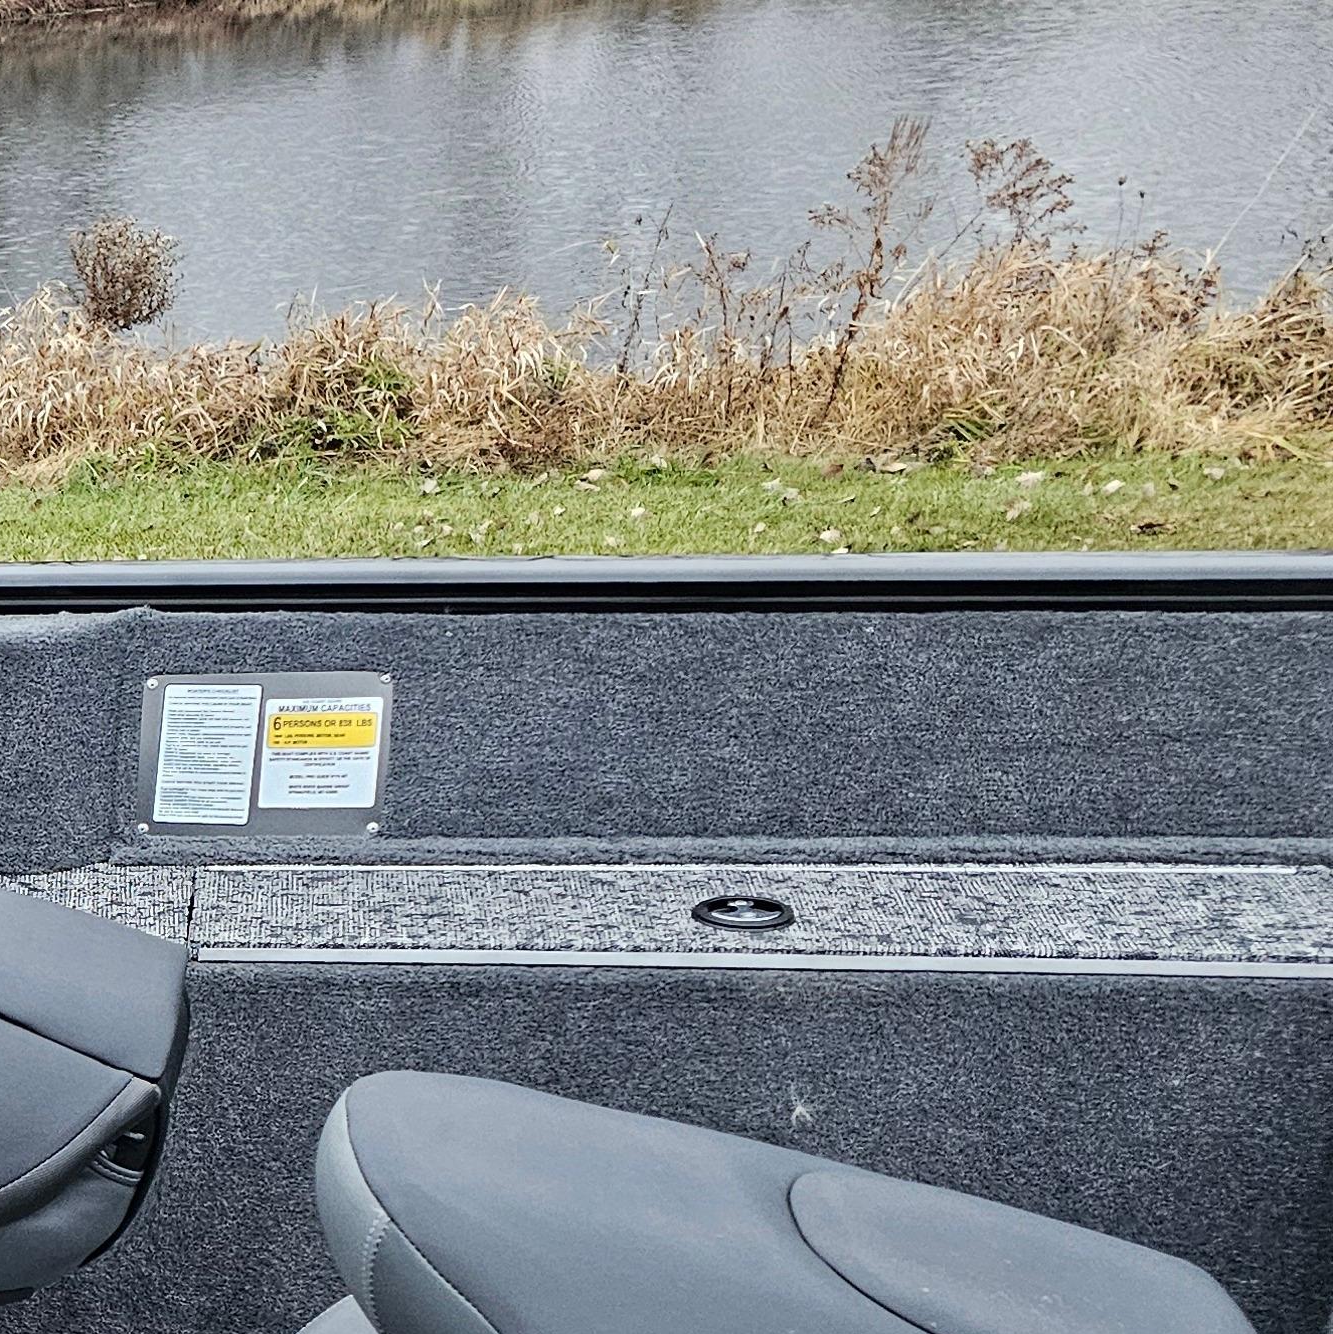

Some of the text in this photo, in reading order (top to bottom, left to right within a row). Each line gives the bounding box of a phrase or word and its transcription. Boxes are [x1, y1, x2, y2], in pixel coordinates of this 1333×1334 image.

[320, 703, 372, 712] CAPACITIES
[273, 716, 282, 731] 6
[283, 719, 322, 728] PERSONS
[324, 719, 336, 727] OR
[356, 718, 373, 727] LBS
